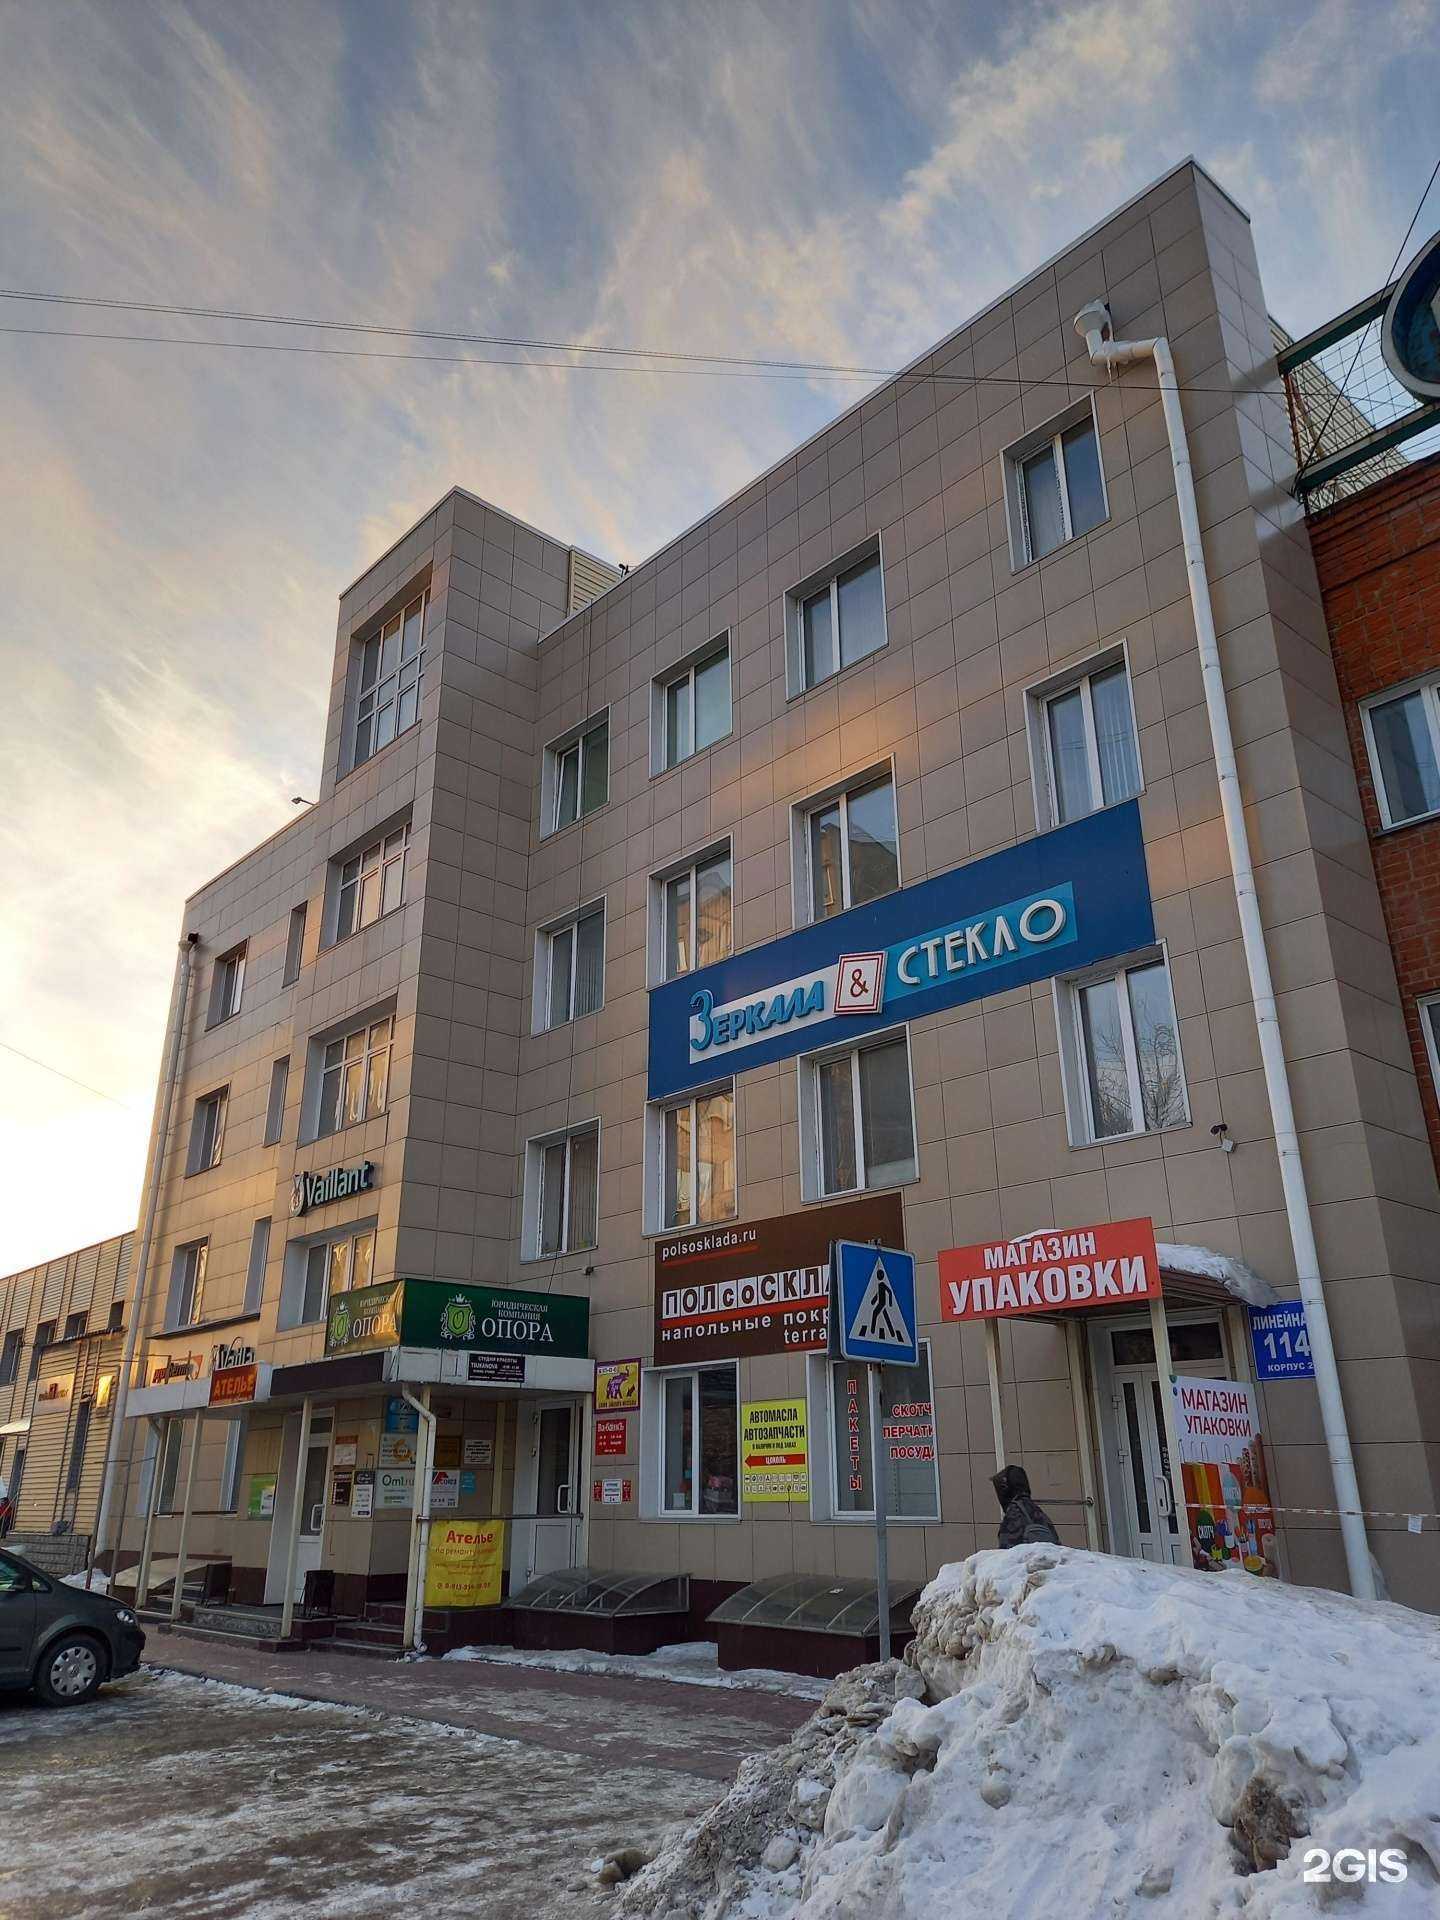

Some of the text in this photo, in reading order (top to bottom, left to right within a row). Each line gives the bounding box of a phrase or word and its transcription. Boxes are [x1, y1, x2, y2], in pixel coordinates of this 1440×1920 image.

[849, 968, 869, 998] &
[897, 899, 1067, 985] СТЕКЛО
[306, 1164, 370, 1207] Vaillant
[661, 1229, 757, 1260] polsosklada.ru
[984, 1231, 1097, 1270] МАГАЗИН
[665, 1266, 829, 1317] ПОЛсоСКЛ
[949, 1256, 1148, 1314] УПАКОВКИ
[491, 1299, 548, 1313] ЮРИДИЧЕСКАЯ
[498, 1309, 541, 1321] КОМПАНИЯ
[353, 1312, 397, 1338] ОПОРА
[481, 1317, 554, 1342] ОПОРА
[661, 1314, 772, 1342] напольные
[1253, 1310, 1307, 1330] ЛИНЕЙНА
[1264, 1330, 1311, 1359] 114
[1268, 1362, 1305, 1372] КОРПУС
[892, 1403, 934, 1418] СКОТЧ
[1181, 1387, 1249, 1415] МАГАЗИН
[749, 1408, 798, 1424] АВТОМАСЛА
[1184, 1414, 1252, 1438] УПАКОВКИ
[744, 1425, 806, 1441] АВТОЗАПЧАСТИ
[847, 1379, 863, 1491] ПАКЕТЫ
[446, 1530, 495, 1545] Ателье
